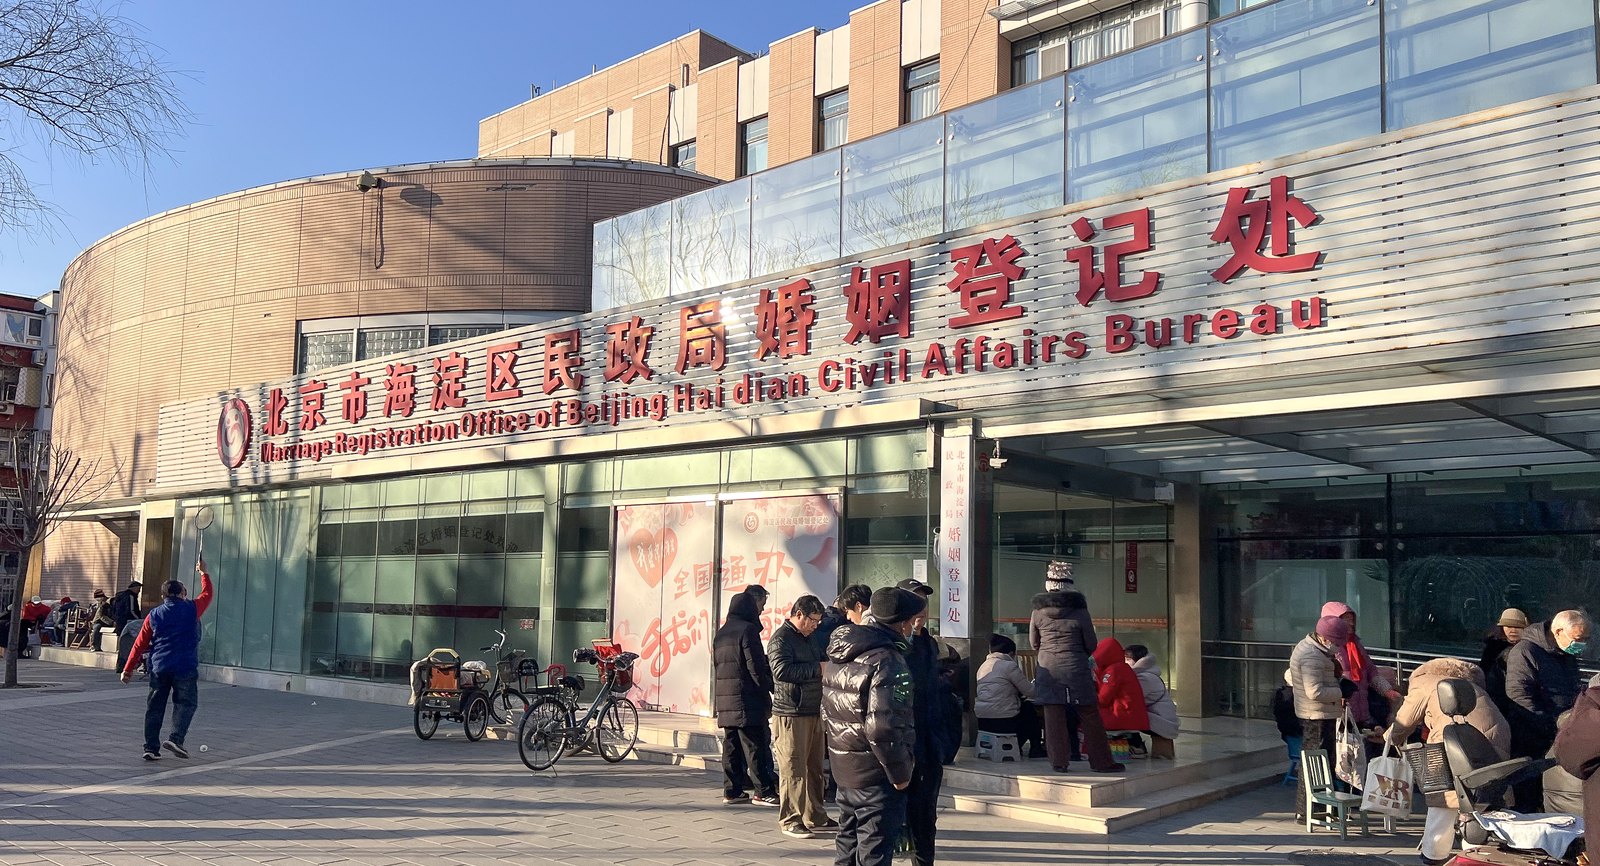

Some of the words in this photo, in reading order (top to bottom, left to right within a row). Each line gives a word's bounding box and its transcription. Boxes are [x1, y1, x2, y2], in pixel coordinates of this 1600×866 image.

[262, 175, 1323, 437] 北京市海淀区民政局婚姻登记处
[261, 438, 332, 462] Marriage
[335, 420, 457, 455] Registration
[460, 410, 530, 437] Office
[535, 400, 562, 428] of
[566, 392, 667, 426] Beijing
[818, 349, 908, 392] Civil
[921, 328, 1087, 379] Affairs
[1105, 296, 1325, 354] Bureau
[945, 451, 954, 518] 民政局
[956, 450, 965, 518] 北京市海淀区
[673, 544, 794, 600] 全国通办
[947, 527, 961, 623] 婚姻登记处
